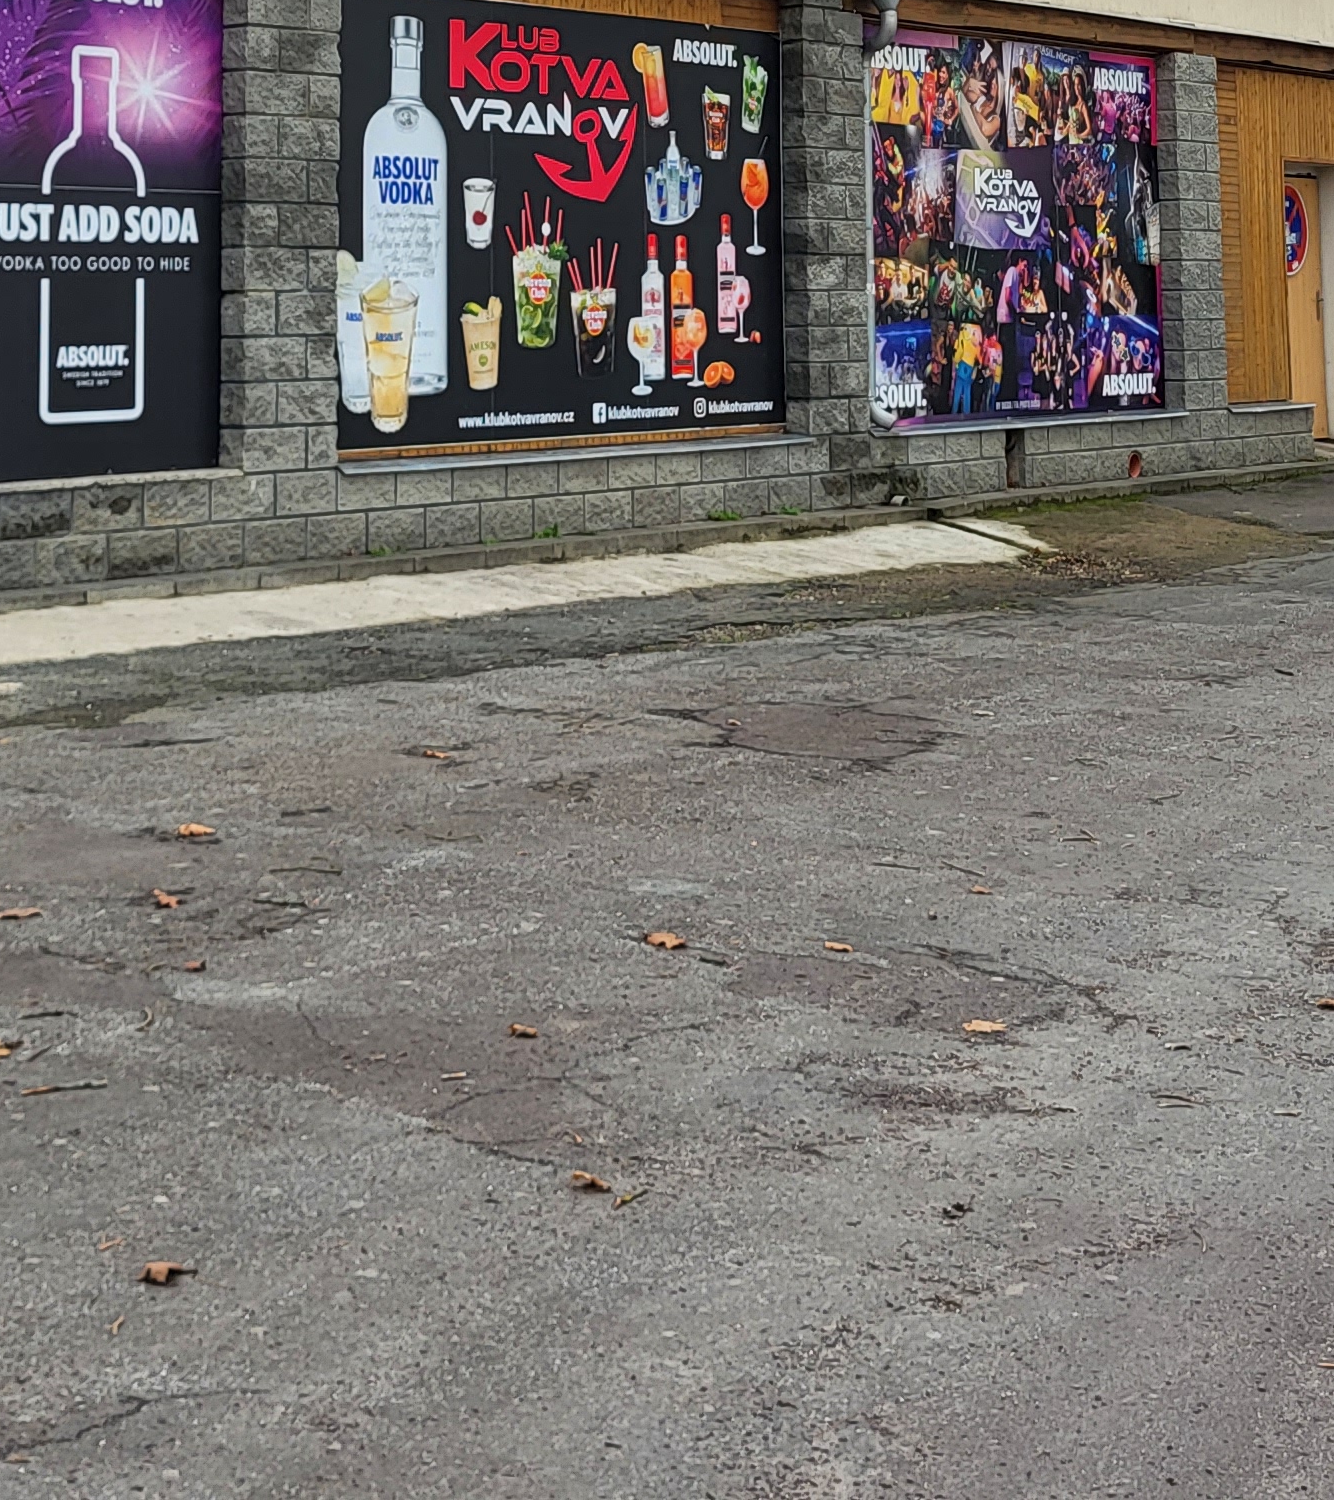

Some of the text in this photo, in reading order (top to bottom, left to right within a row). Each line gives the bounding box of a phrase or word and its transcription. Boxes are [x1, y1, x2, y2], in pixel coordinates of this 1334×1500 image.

[449, 18, 560, 91] KLUB
[449, 18, 630, 101] KOTVA
[449, 91, 629, 143] VRANOV
[372, 155, 439, 182] ABSOLUT
[378, 180, 434, 205] VODKA
[974, 167, 1039, 198] KOTVA
[975, 195, 1039, 214] VRANOV
[58, 204, 121, 243] ADD
[123, 205, 200, 244] SODA
[50, 255, 82, 271] TOO
[86, 255, 131, 271] GOOD
[136, 256, 155, 271] TO
[159, 257, 191, 271] HIDE
[457, 410, 575, 430] www.klubkotvavranov.cz
[608, 404, 680, 420] klubkotvavranov
[708, 400, 773, 415] klubkotvavranov
